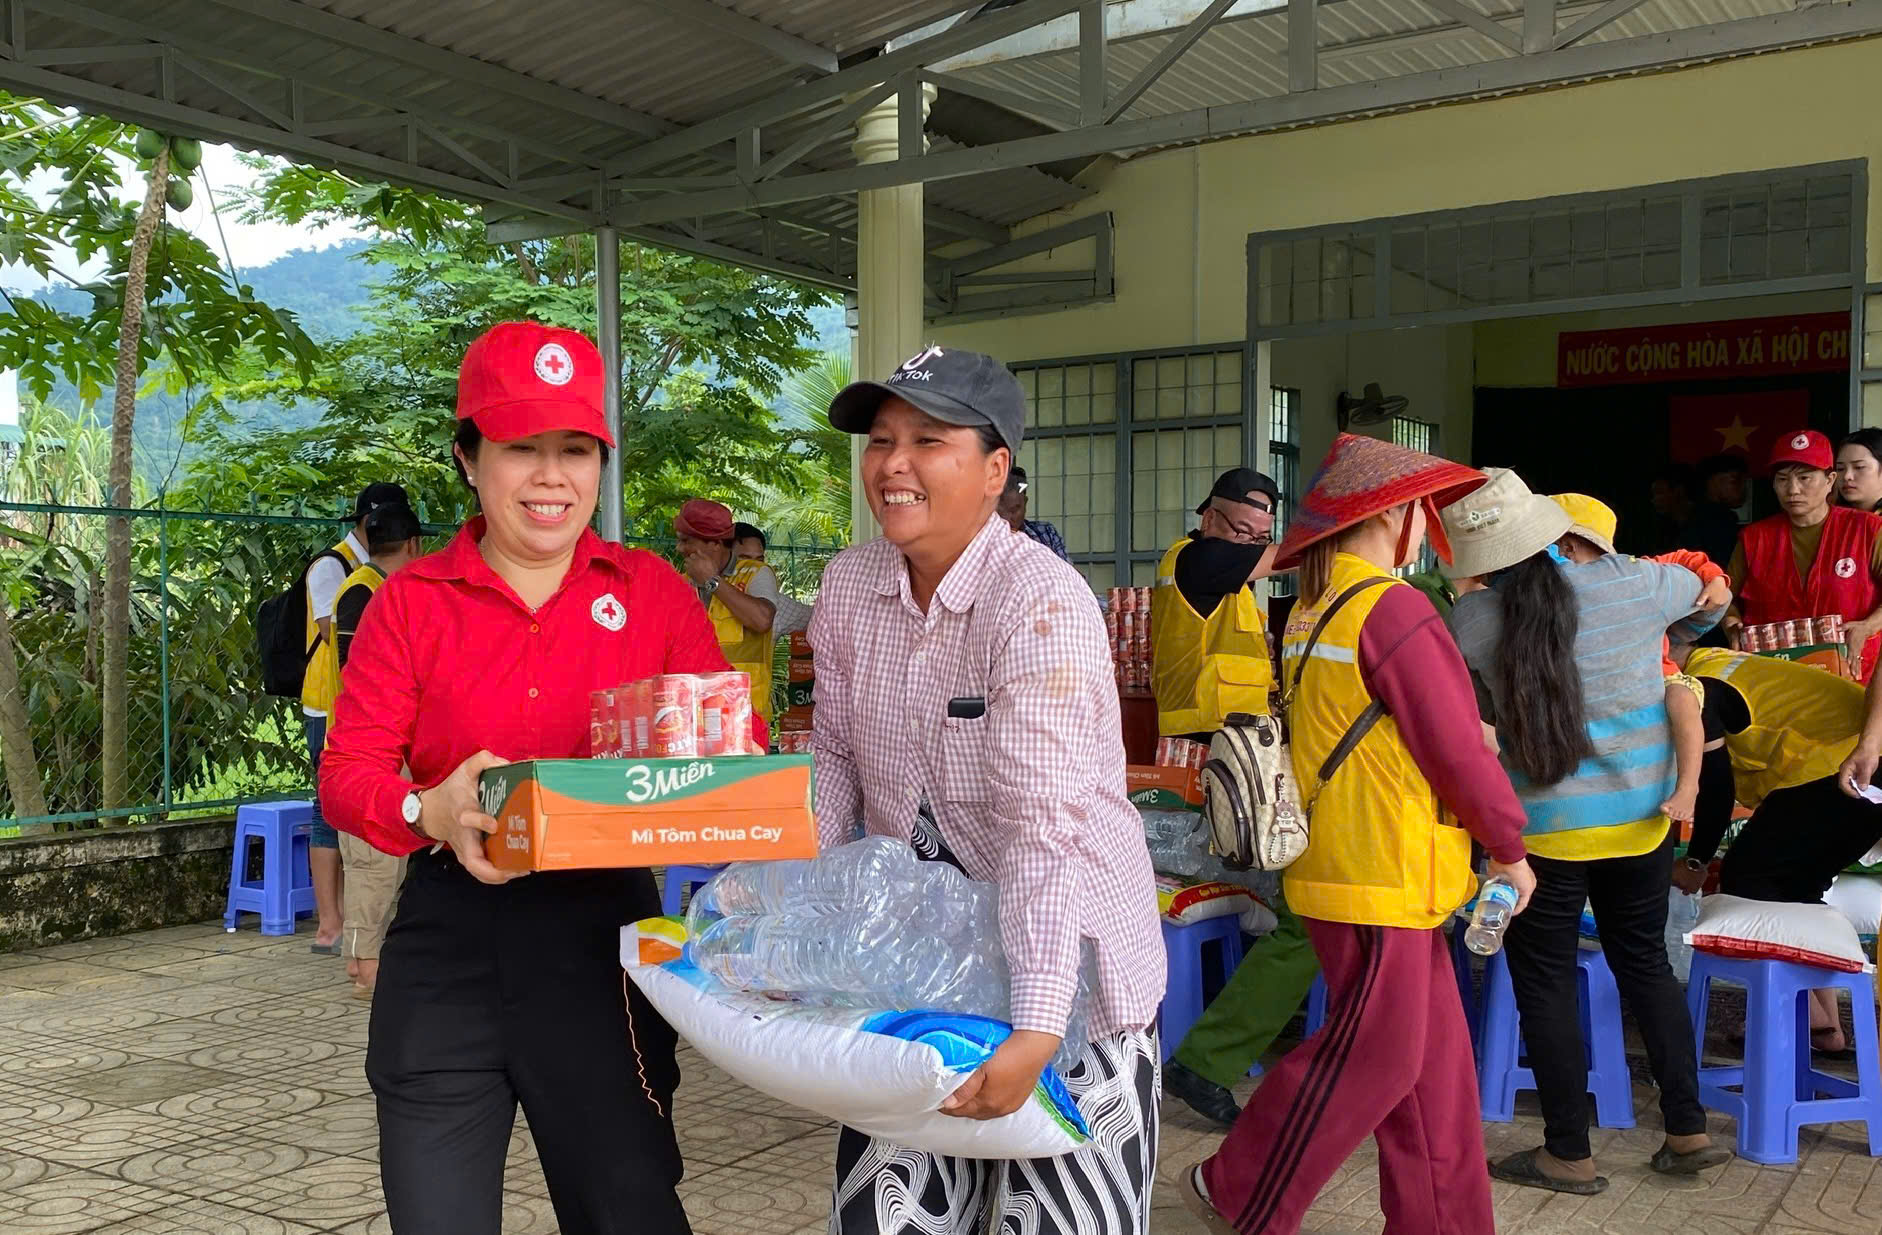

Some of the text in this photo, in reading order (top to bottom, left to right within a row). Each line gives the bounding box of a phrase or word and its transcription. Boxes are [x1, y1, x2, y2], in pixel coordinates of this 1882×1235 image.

[1566, 340, 1619, 376] NƯỚC
[1626, 337, 1680, 377] CỘNG
[1687, 332, 1729, 367] HÒA
[1736, 329, 1763, 365] XÃ
[1772, 325, 1808, 367] HỘI
[631, 825, 784, 845] Mì Tôm Chua Cay
